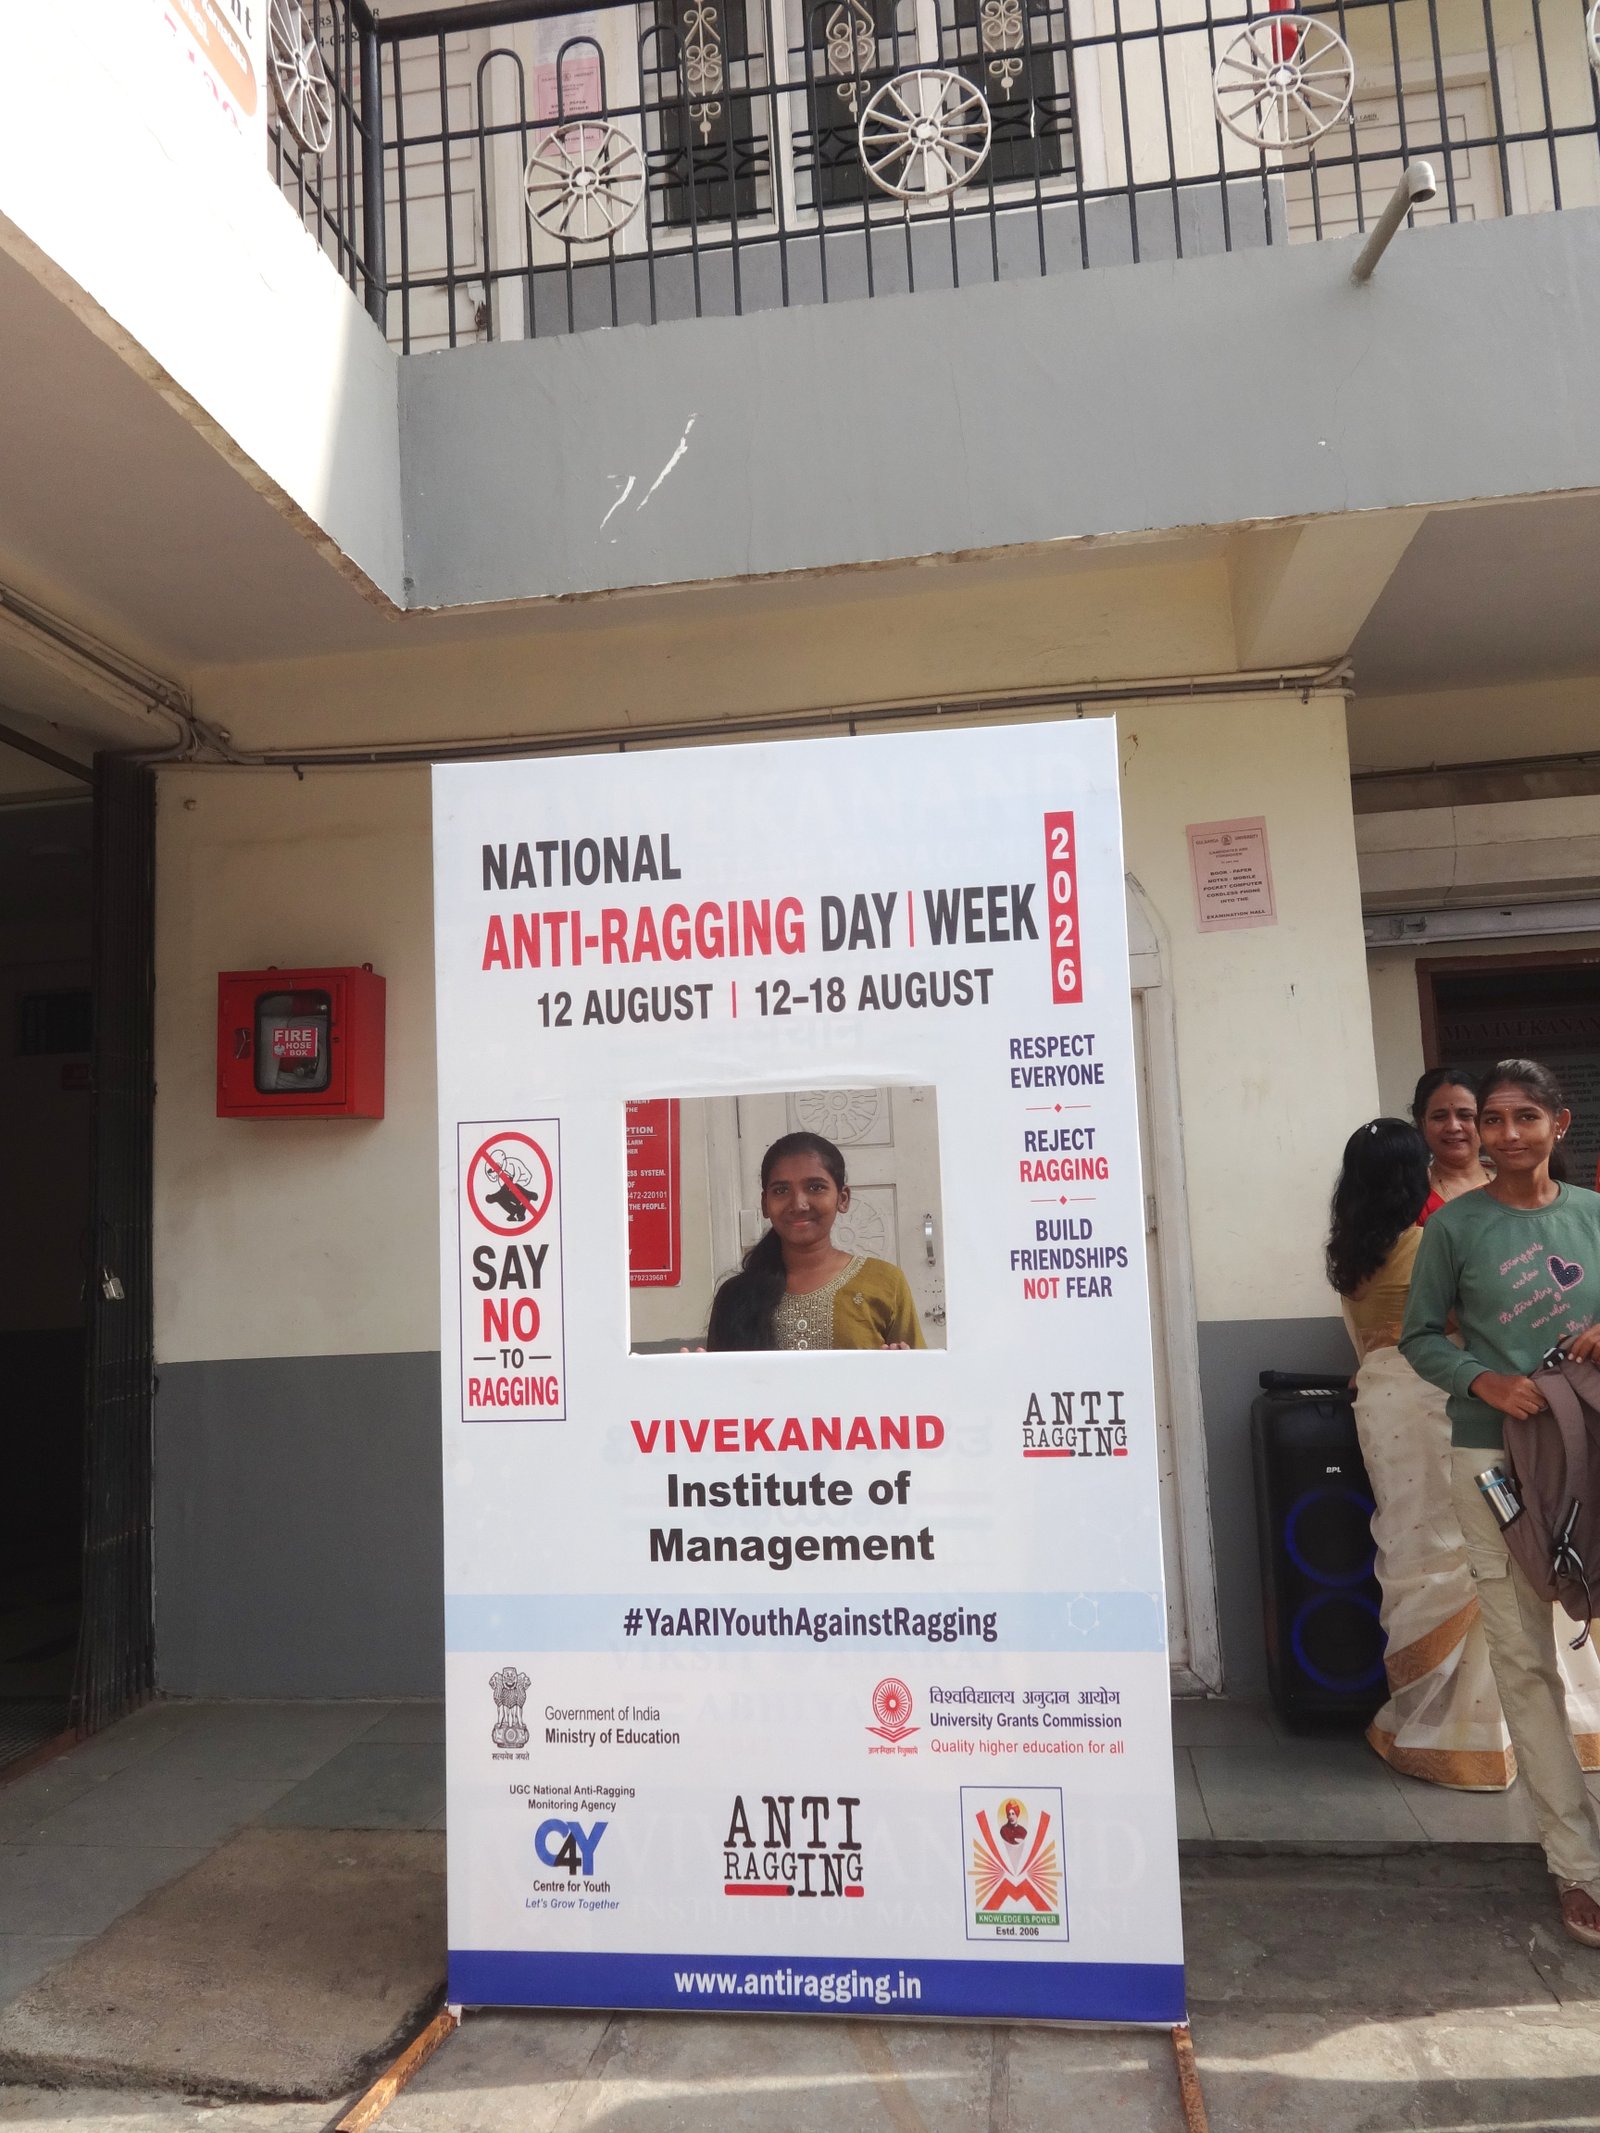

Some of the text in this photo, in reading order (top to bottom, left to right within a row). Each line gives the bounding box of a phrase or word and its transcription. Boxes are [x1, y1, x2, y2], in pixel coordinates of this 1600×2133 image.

[483, 833, 681, 891] NATIONAL
[1050, 826, 1078, 993] 2026
[482, 883, 1039, 971] ANTI-RAGGING DAY WEEK
[538, 991, 572, 1027] 12
[583, 984, 713, 1025] AUGUST
[858, 968, 993, 1011] AUGUST
[274, 1030, 312, 1041] FIRE
[1010, 1034, 1095, 1059] RESPECT
[1011, 1063, 1104, 1088] EVERYONE
[626, 1126, 653, 1134] PTION
[1025, 1128, 1095, 1152] REJECT
[640, 1169, 666, 1177] SYSTEM.
[1020, 1157, 1108, 1182] RAGGING
[628, 1191, 667, 1199] 472-220101
[1036, 1218, 1092, 1241] BUILD
[472, 1244, 549, 1291] SAY
[1011, 1246, 1128, 1271] FRIENDSHIPS
[1024, 1276, 1112, 1299] NOT FEAR
[483, 1297, 540, 1342] NO
[500, 1348, 524, 1369] TO
[469, 1376, 558, 1406] RAGGING
[1023, 1391, 1126, 1426] ANTI
[630, 1415, 944, 1453] VIVEKANAND
[1023, 1426, 1128, 1458] RAGGING
[668, 1470, 911, 1507] Institute of
[650, 1527, 935, 1570] Management
[624, 1607, 997, 1642] #YaARIYouthAgainstRagging
[929, 1686, 1120, 1709] विश्वविद्यालय अनुदान आयोग
[545, 1706, 660, 1721] Government of India
[931, 1713, 1121, 1730] University Grants Commission
[546, 1728, 679, 1747] Ministry of Education
[931, 1739, 974, 1755] Quality
[980, 1740, 1018, 1756] higher
[1023, 1741, 1083, 1753] education
[1089, 1740, 1105, 1753] for
[1110, 1741, 1123, 1753] all
[510, 1785, 635, 1798] UGC National Anti-Ragging
[528, 1799, 616, 1812] Monitoring Agency
[724, 1795, 862, 1851] ANTI
[533, 1880, 610, 1892] Centre for Youth
[723, 1851, 864, 1898] RAGGING
[526, 1898, 619, 1911] Let's Grow Together
[979, 1914, 1057, 1924] KNOWLEDGE IS POWER
[996, 1926, 1039, 1936] Estd. 2006
[675, 1969, 920, 2004] www.antiragging.in
